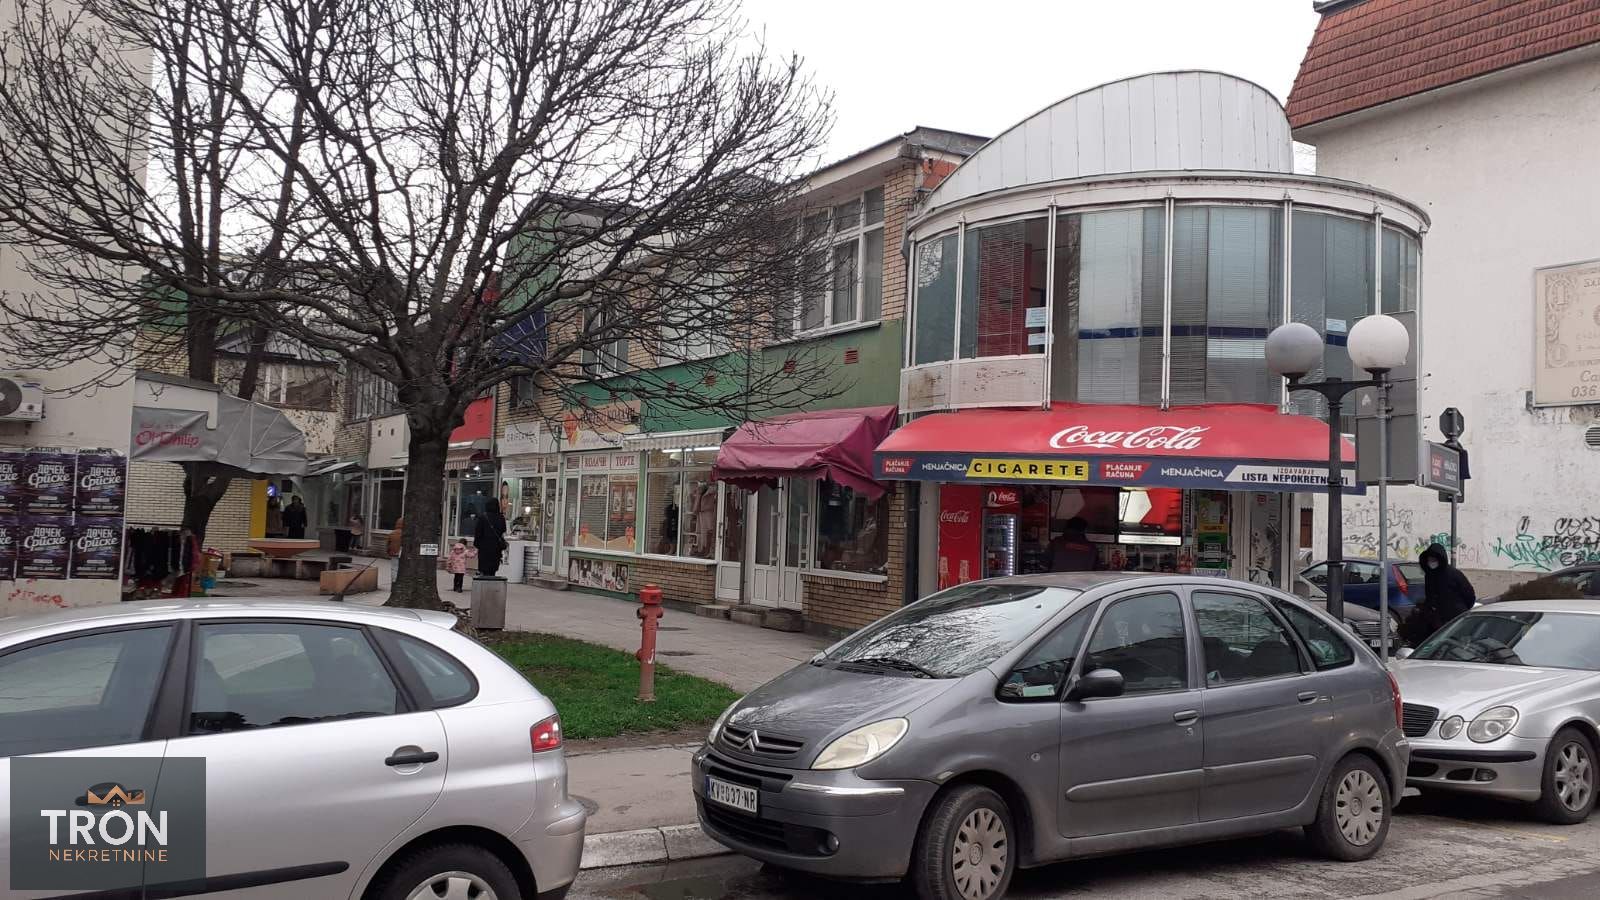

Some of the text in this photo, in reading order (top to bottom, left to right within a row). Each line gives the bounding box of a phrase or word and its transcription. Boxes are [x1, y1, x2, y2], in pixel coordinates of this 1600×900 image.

[1050, 425, 1211, 450] Coca-Cola
[38, 464, 65, 475] ДОЧЕК
[90, 466, 118, 477] ДОЧЕК
[921, 461, 968, 471] MENJAČNICA
[973, 462, 1084, 476] CIGARETE
[1161, 466, 1224, 478] MENJAČNICA
[1241, 473, 1349, 485] LISTA NEPOKRETNTI
[33, 527, 61, 537] ДОЧЕК
[86, 528, 113, 538] ДОЧЕК
